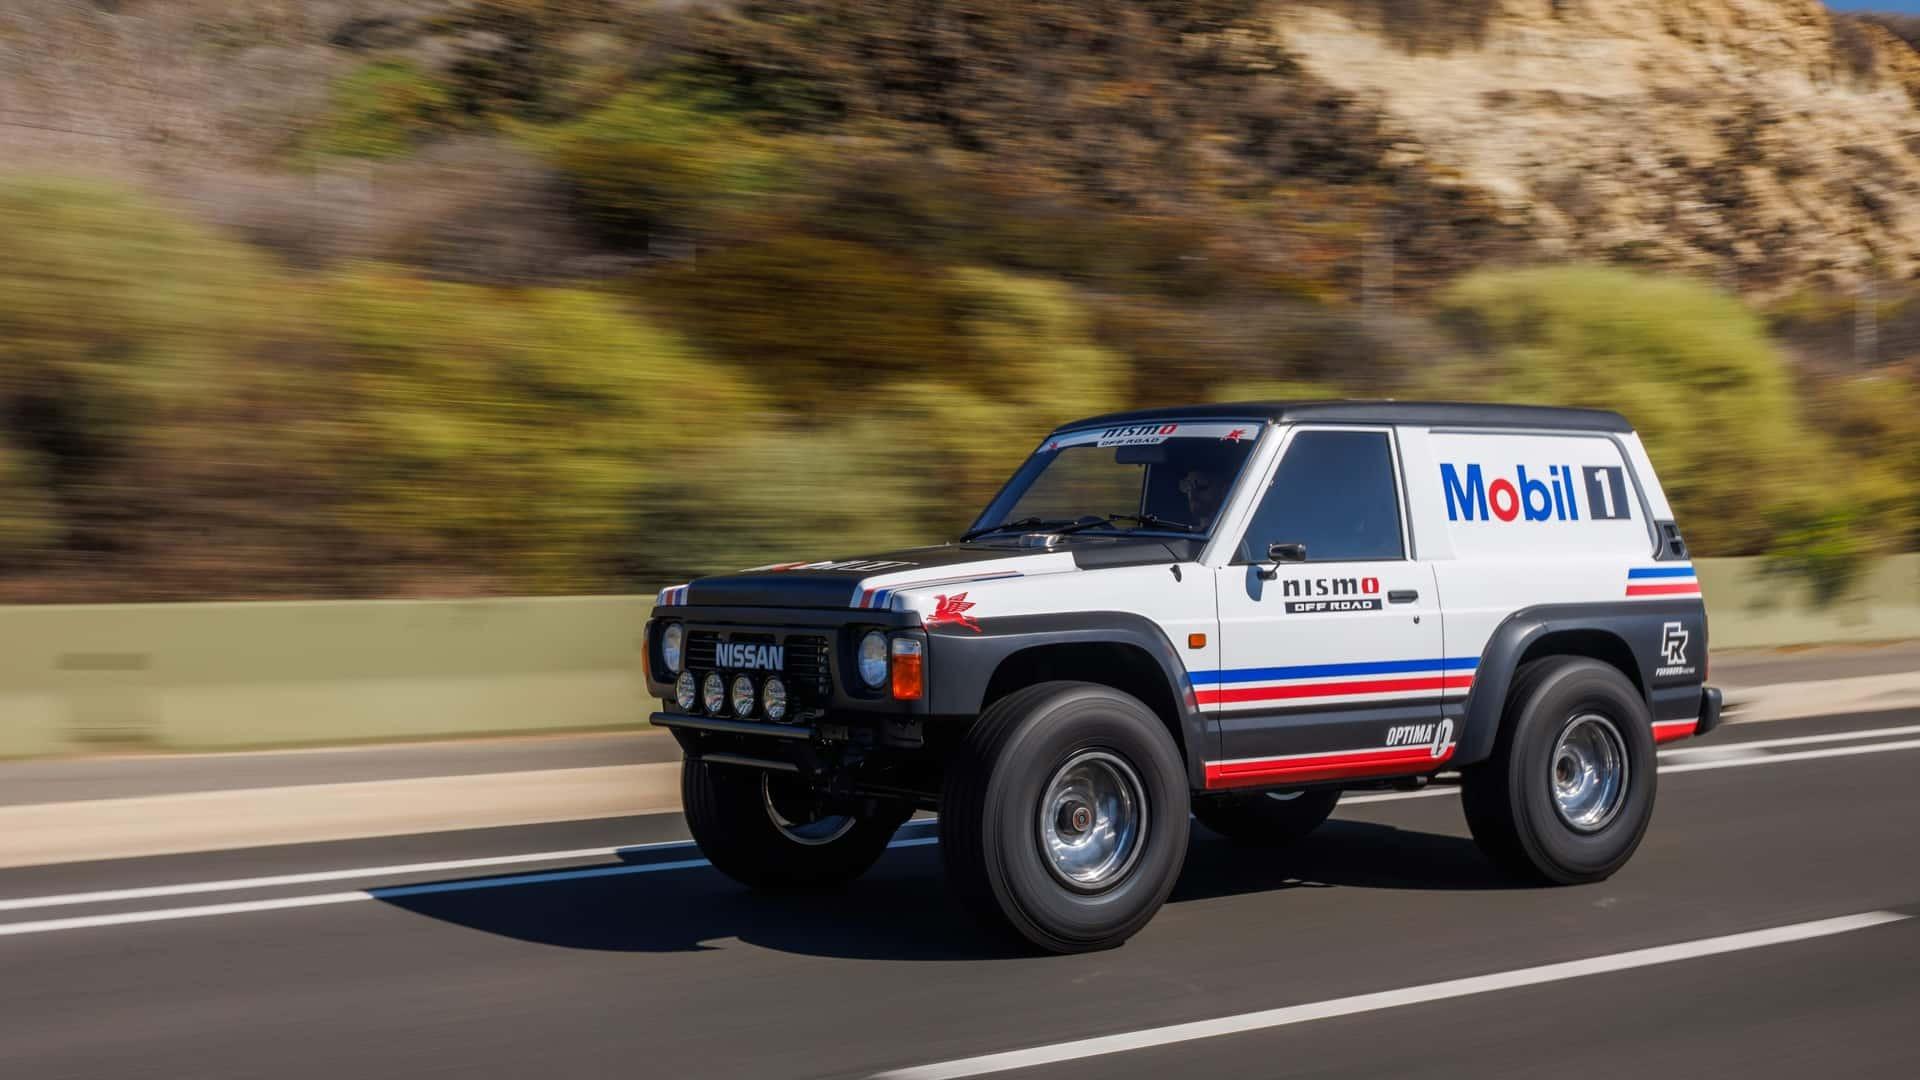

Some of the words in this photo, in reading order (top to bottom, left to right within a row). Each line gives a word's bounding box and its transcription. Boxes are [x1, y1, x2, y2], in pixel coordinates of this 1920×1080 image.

[1439, 463, 1578, 521] Mobil
[1592, 467, 1618, 519] 1
[1294, 602, 1326, 612] OFF
[1330, 600, 1373, 610] ROAD
[715, 643, 784, 671] NISSAN
[1386, 724, 1433, 746] OPTIMA
